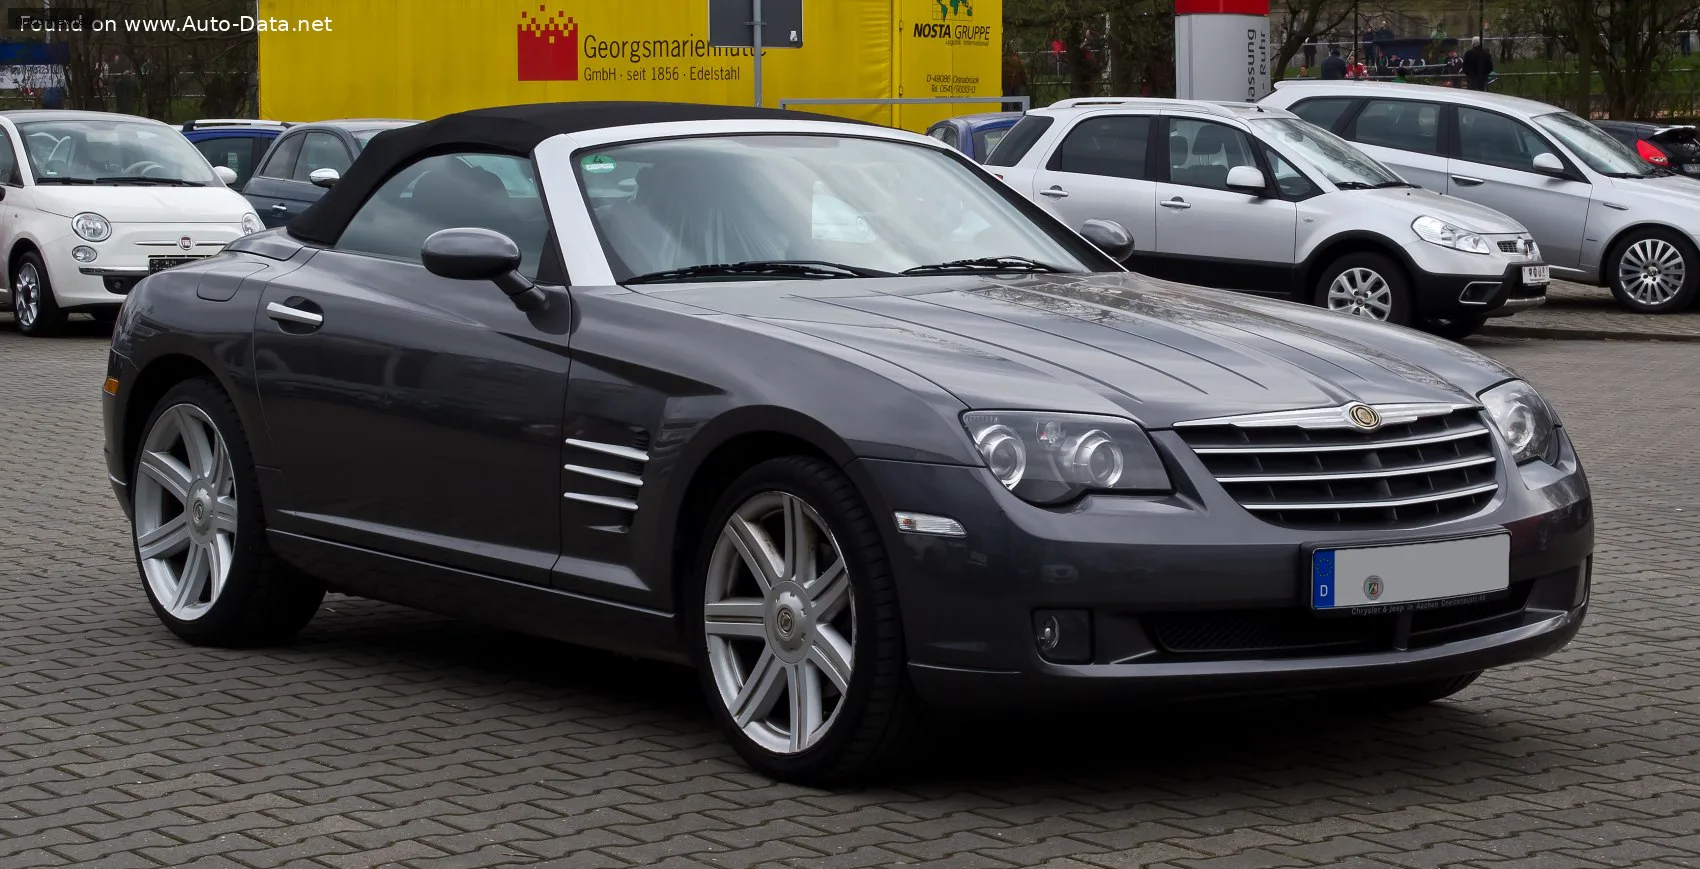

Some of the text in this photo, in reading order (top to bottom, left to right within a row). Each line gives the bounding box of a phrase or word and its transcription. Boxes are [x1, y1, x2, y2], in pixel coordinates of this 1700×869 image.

[913, 23, 990, 40] NOSTA GRUPPE
[584, 66, 740, 81] GmbH seit 1856 Edelstahl
[1319, 584, 1329, 597] D
[1351, 606, 1381, 616] Chrysler
